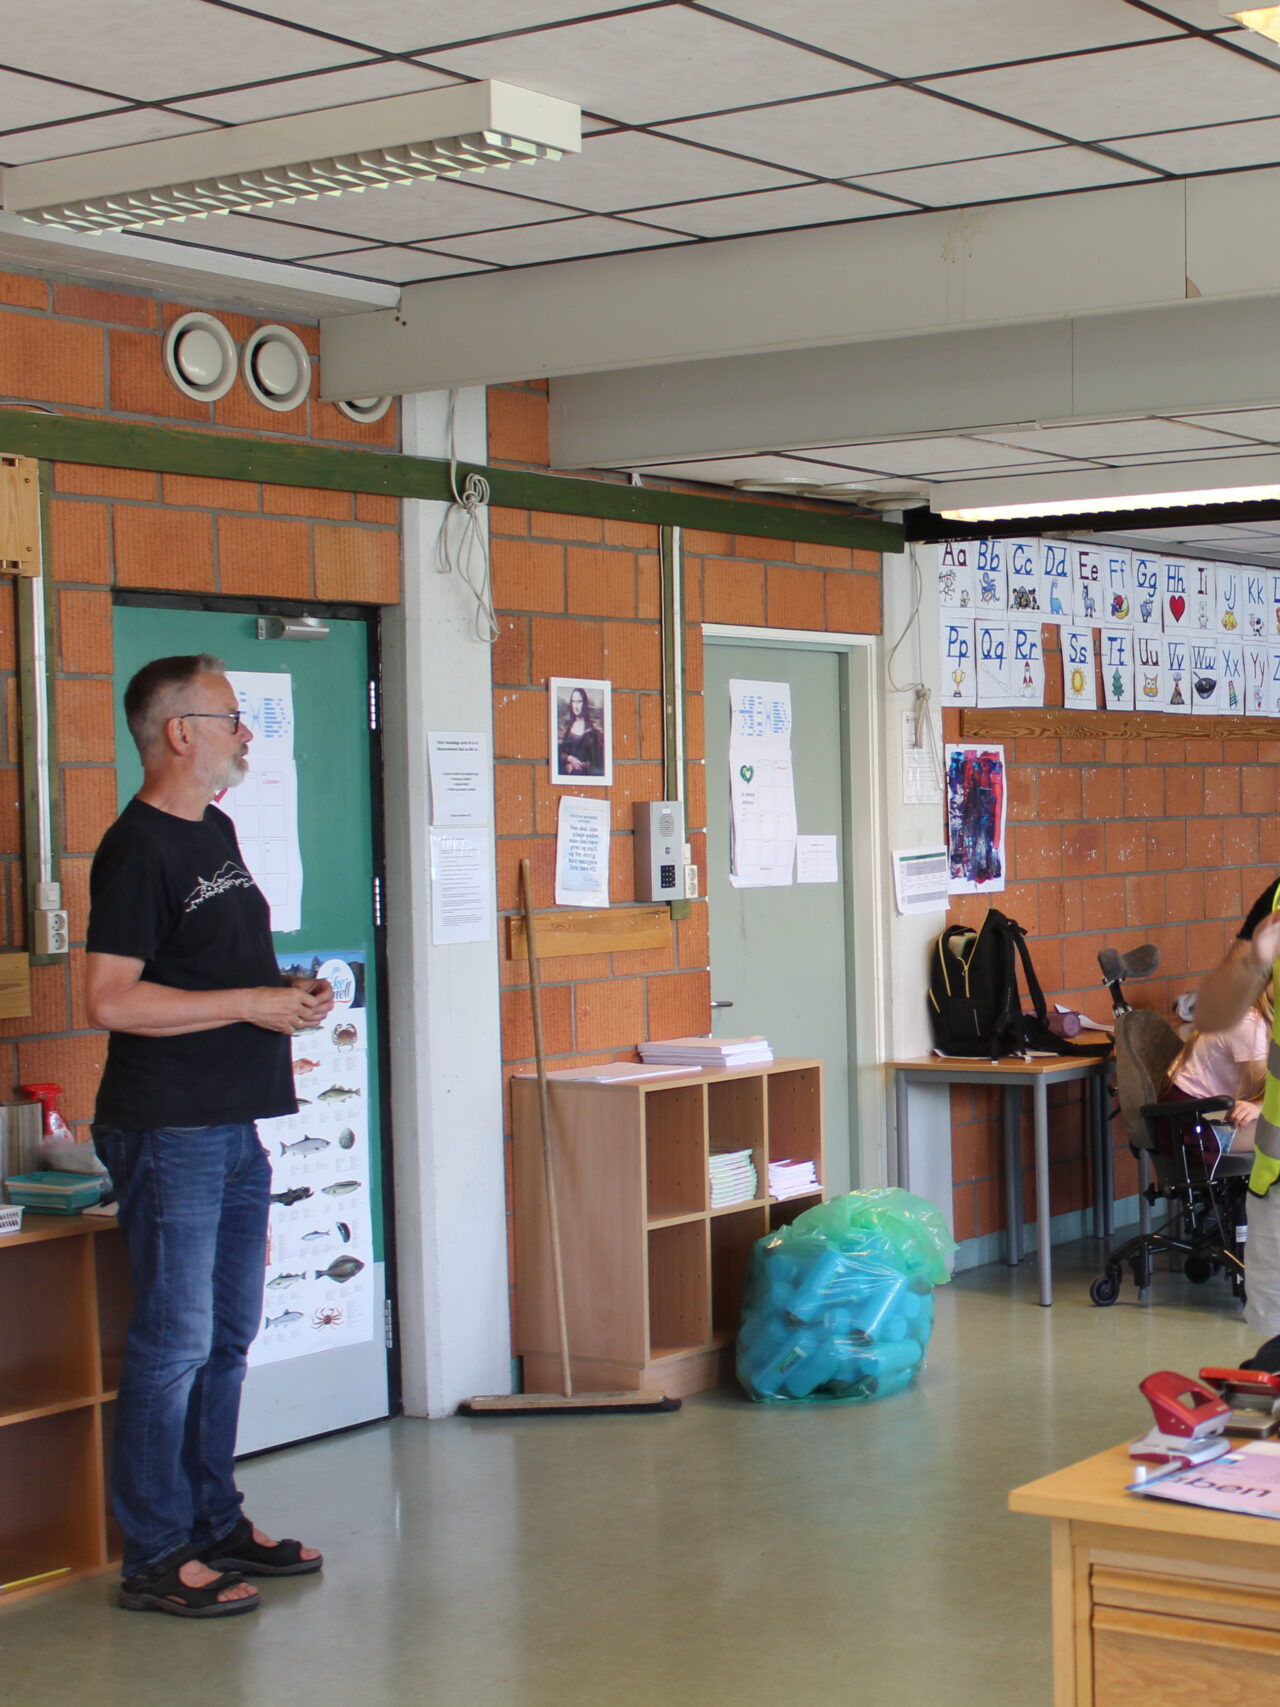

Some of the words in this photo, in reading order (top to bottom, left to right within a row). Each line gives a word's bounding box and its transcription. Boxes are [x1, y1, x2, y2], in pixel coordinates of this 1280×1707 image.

[942, 541, 967, 566] Aa
[977, 540, 1000, 571] Bb
[1013, 545, 1033, 574] Cc
[1044, 546, 1067, 576] Dd
[1079, 551, 1099, 580] Ee
[1109, 559, 1126, 589] Ff
[1137, 560, 1157, 598] Gg
[1167, 565, 1185, 592] Hh
[1198, 567, 1208, 595] Ii
[1224, 575, 1236, 610] Jj
[1248, 576, 1264, 605] Kk
[947, 627, 968, 667] Pp
[981, 629, 1005, 670] Qq
[1015, 630, 1038, 659] Rr
[1069, 634, 1088, 663] Ss
[1107, 637, 1125, 665] Tt
[1138, 638, 1159, 666] Uu
[1168, 643, 1184, 670] Vv
[1192, 646, 1216, 669] Ww
[1222, 650, 1240, 677] Xx
[1251, 652, 1265, 688] Yy
